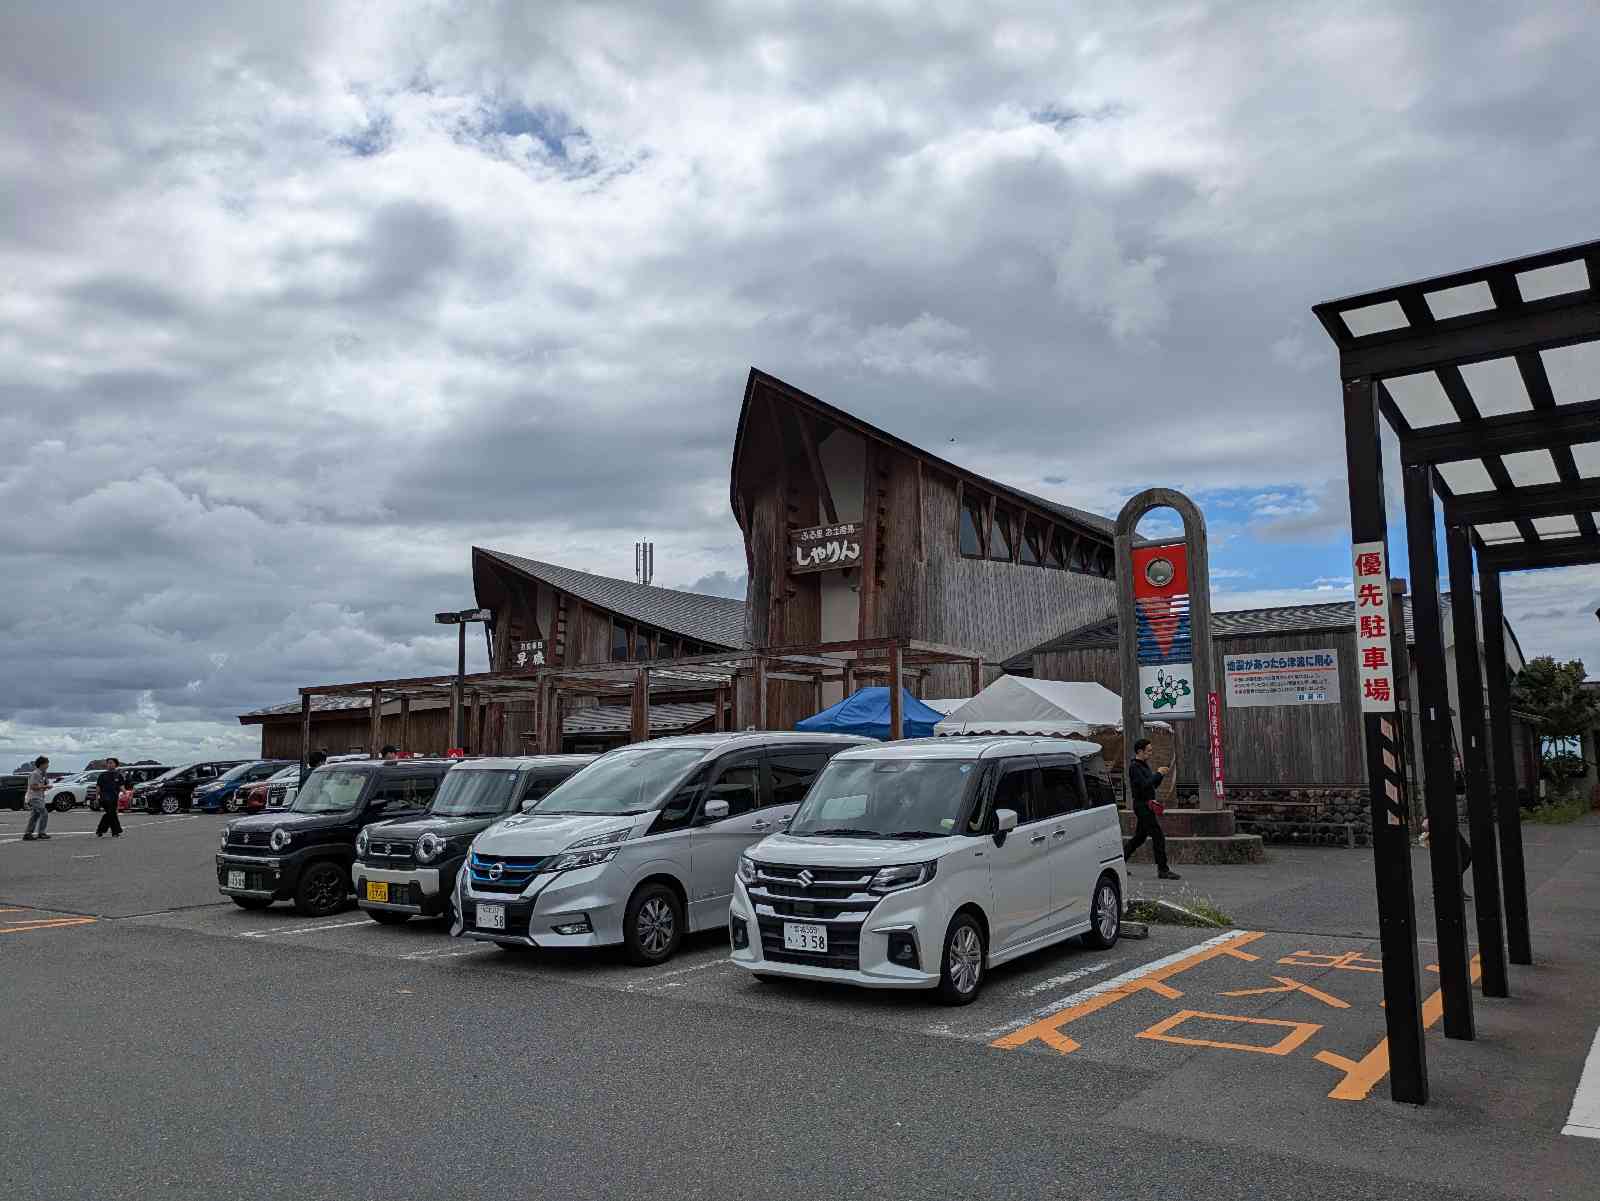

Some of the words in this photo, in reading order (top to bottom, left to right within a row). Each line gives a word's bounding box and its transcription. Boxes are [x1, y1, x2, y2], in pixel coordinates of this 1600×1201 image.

[796, 539, 860, 565] しゃりん
[1355, 551, 1391, 702] 優先駐車場
